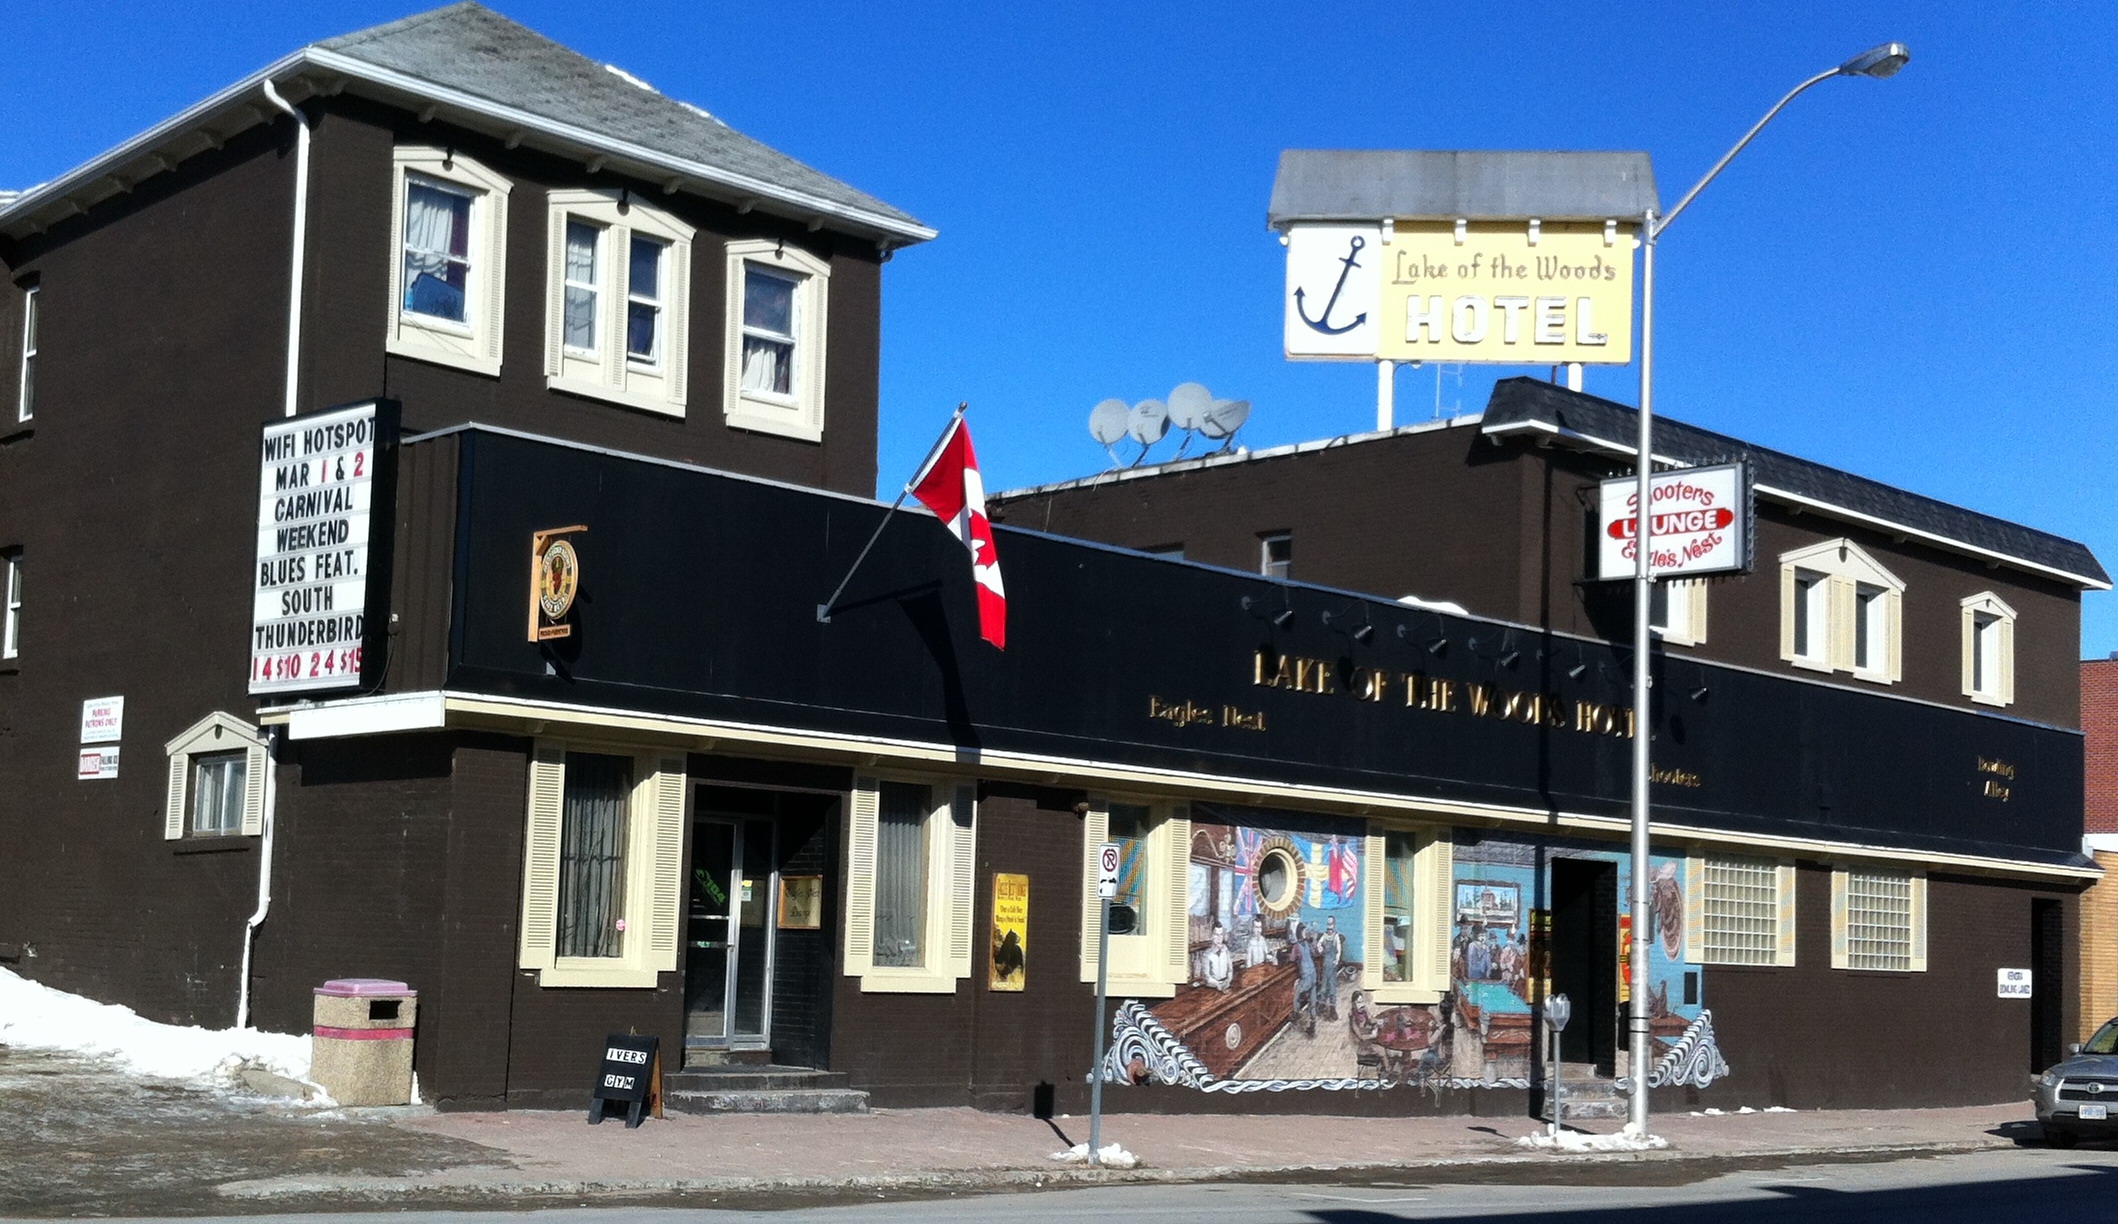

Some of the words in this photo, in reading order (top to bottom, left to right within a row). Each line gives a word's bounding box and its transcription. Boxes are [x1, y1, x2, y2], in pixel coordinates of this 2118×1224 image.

[1391, 250, 1449, 285] Lake
[1457, 252, 1483, 280] of
[1490, 254, 1528, 280] the
[1536, 254, 1617, 281] Woods
[1404, 294, 1608, 346] HOTEL
[264, 434, 296, 462] WIFI
[303, 416, 376, 455] HOTSPOT
[275, 463, 309, 491] MAR
[321, 459, 328, 483] 1
[335, 456, 345, 481] &
[353, 451, 364, 477] 2
[274, 486, 353, 522] CARNIVAL
[276, 519, 350, 552] WEEKEND
[1622, 510, 1718, 538] LUNGE
[1677, 532, 1723, 568] Nest
[260, 555, 306, 587] BLUES
[315, 550, 358, 579] FEAT.
[281, 585, 334, 616] SOUTH
[255, 614, 363, 650] THUNDERBIRD
[262, 657, 272, 680] 4
[276, 654, 301, 679] $10
[309, 651, 321, 677] 2
[324, 649, 335, 675] 4
[1253, 650, 1335, 695] LAKE
[1351, 666, 1390, 702] OF
[1402, 673, 1457, 713] THE
[1465, 681, 1566, 728] WOODS
[1148, 695, 1213, 728] Eagles
[609, 1049, 646, 1063] IVERS
[605, 1075, 635, 1088] GYM
